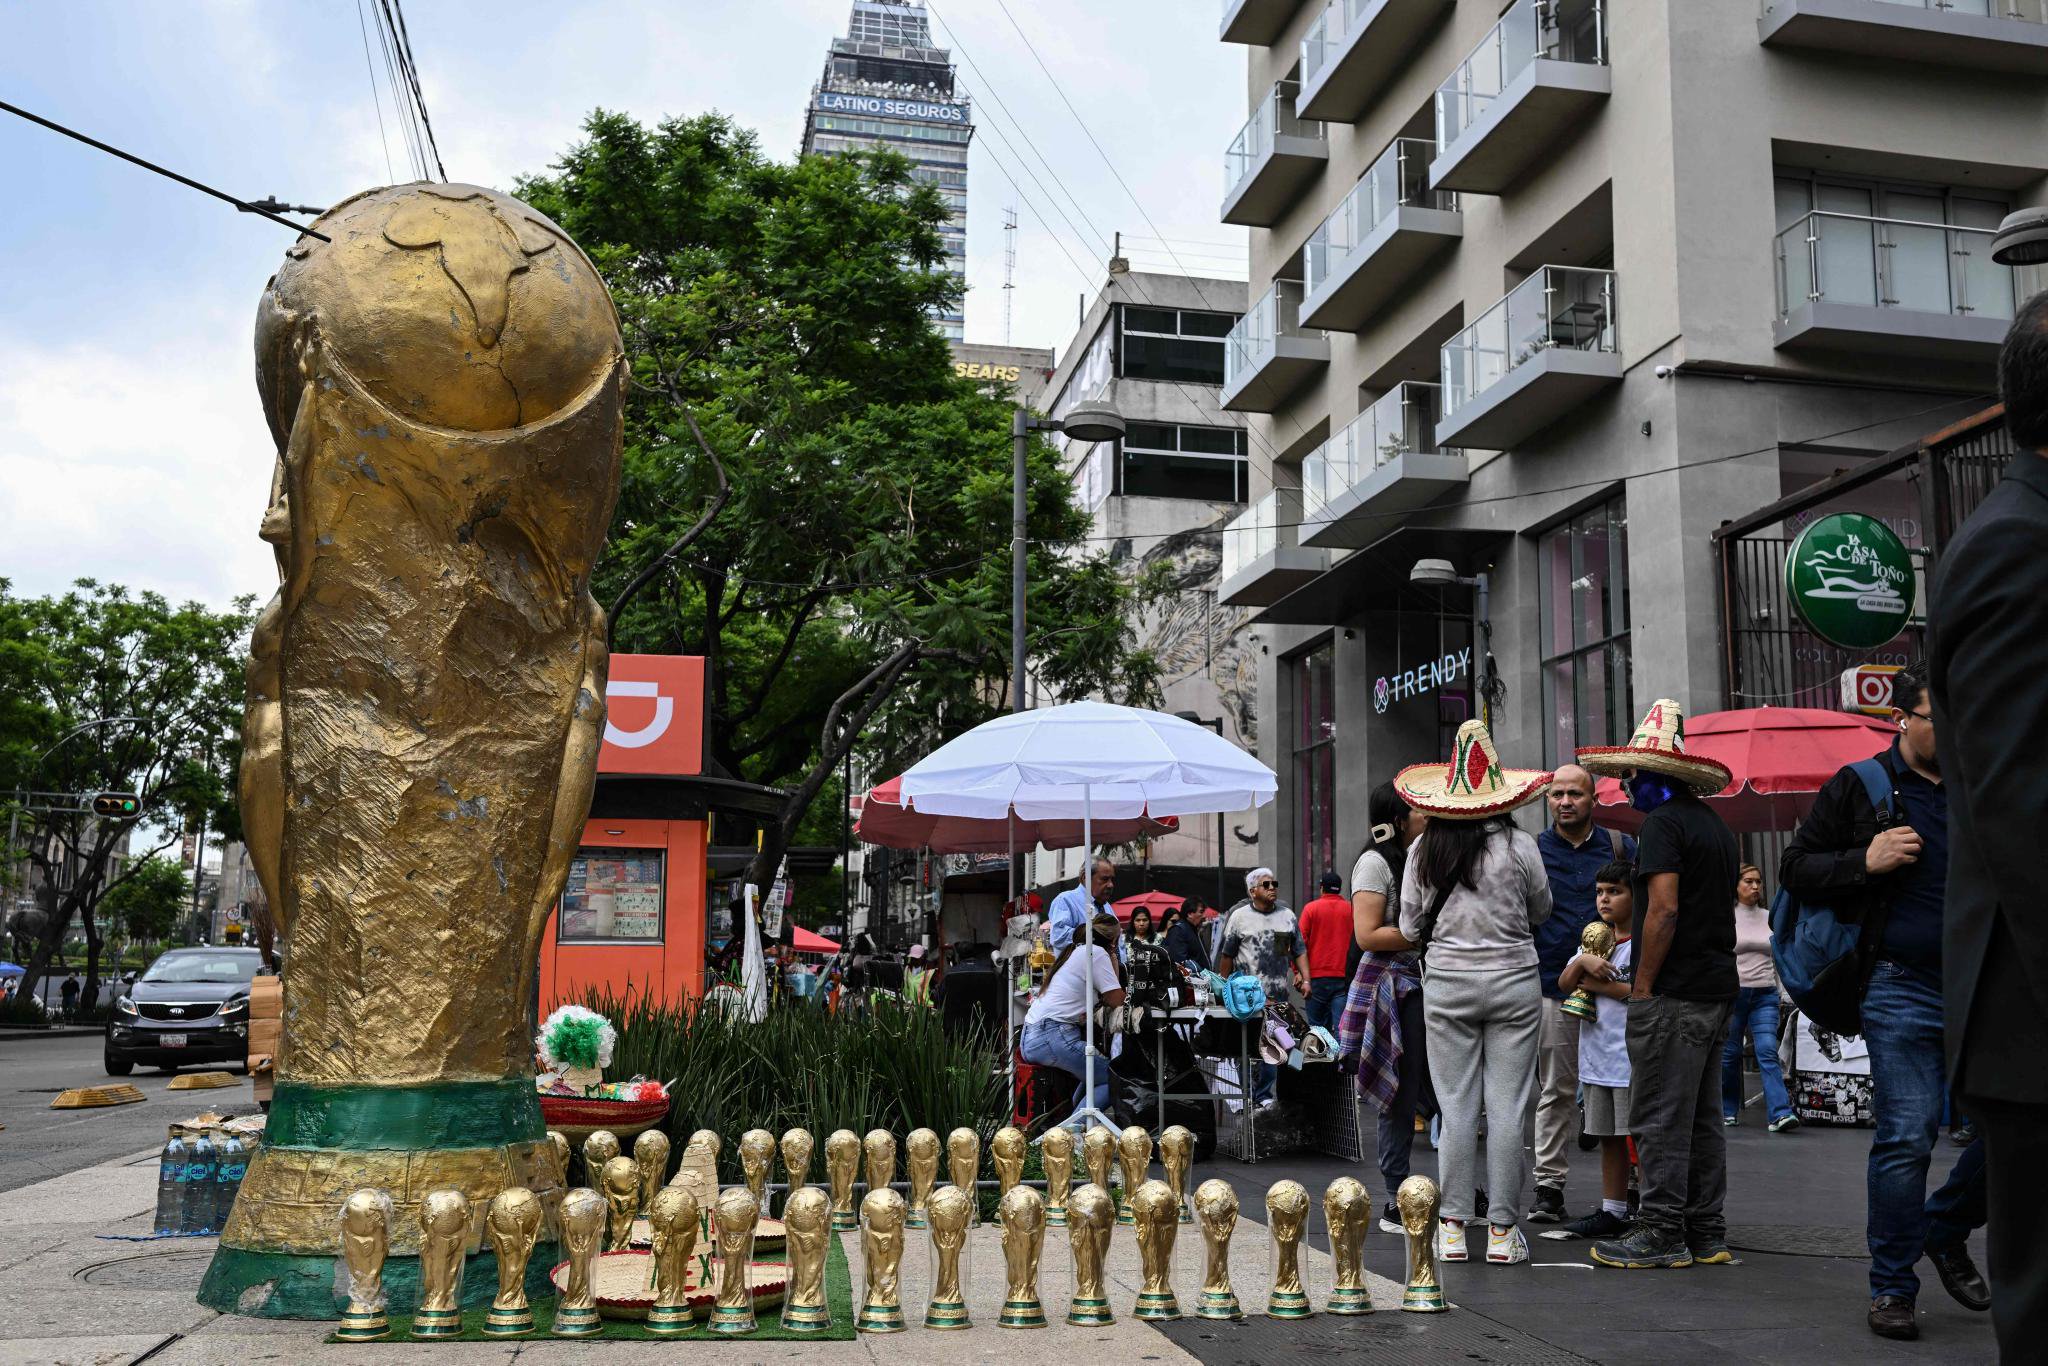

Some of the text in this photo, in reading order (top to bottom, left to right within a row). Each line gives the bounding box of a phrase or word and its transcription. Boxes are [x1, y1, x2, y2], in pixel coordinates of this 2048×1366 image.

[823, 95, 962, 121] LATINO SEGUROS
[955, 362, 1021, 382] SEARS
[1847, 534, 1861, 545] LA
[1836, 544, 1879, 561] CASA
[1851, 554, 1904, 582] DE TOÑO
[1391, 646, 1470, 702] TRENDY
